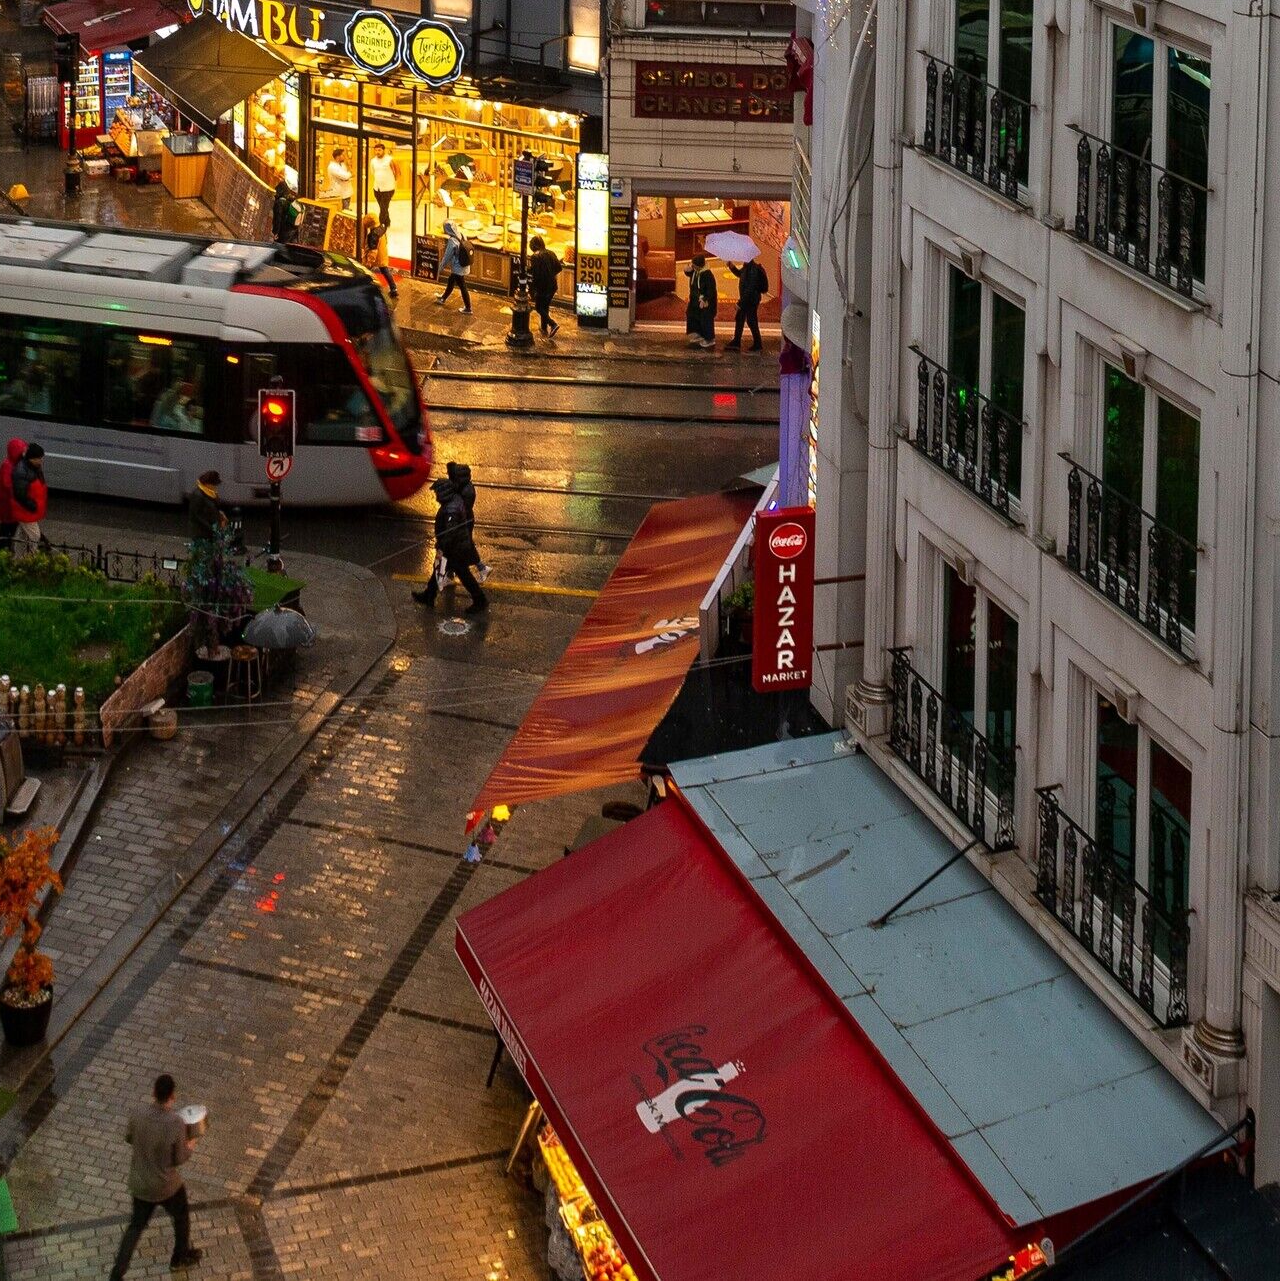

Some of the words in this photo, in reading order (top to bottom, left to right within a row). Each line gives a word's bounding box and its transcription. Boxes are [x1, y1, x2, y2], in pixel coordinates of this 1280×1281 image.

[416, 36, 453, 55] Turkish
[418, 51, 452, 70] delight
[641, 69, 744, 89] SEMBOL
[752, 69, 790, 90] DÖ
[640, 95, 742, 115] CHANGE
[580, 257, 602, 270] 500
[580, 271, 602, 283] 250
[771, 534, 804, 549] Coca-Cola
[775, 563, 797, 670] HAZAR
[762, 670, 808, 684] MARKET
